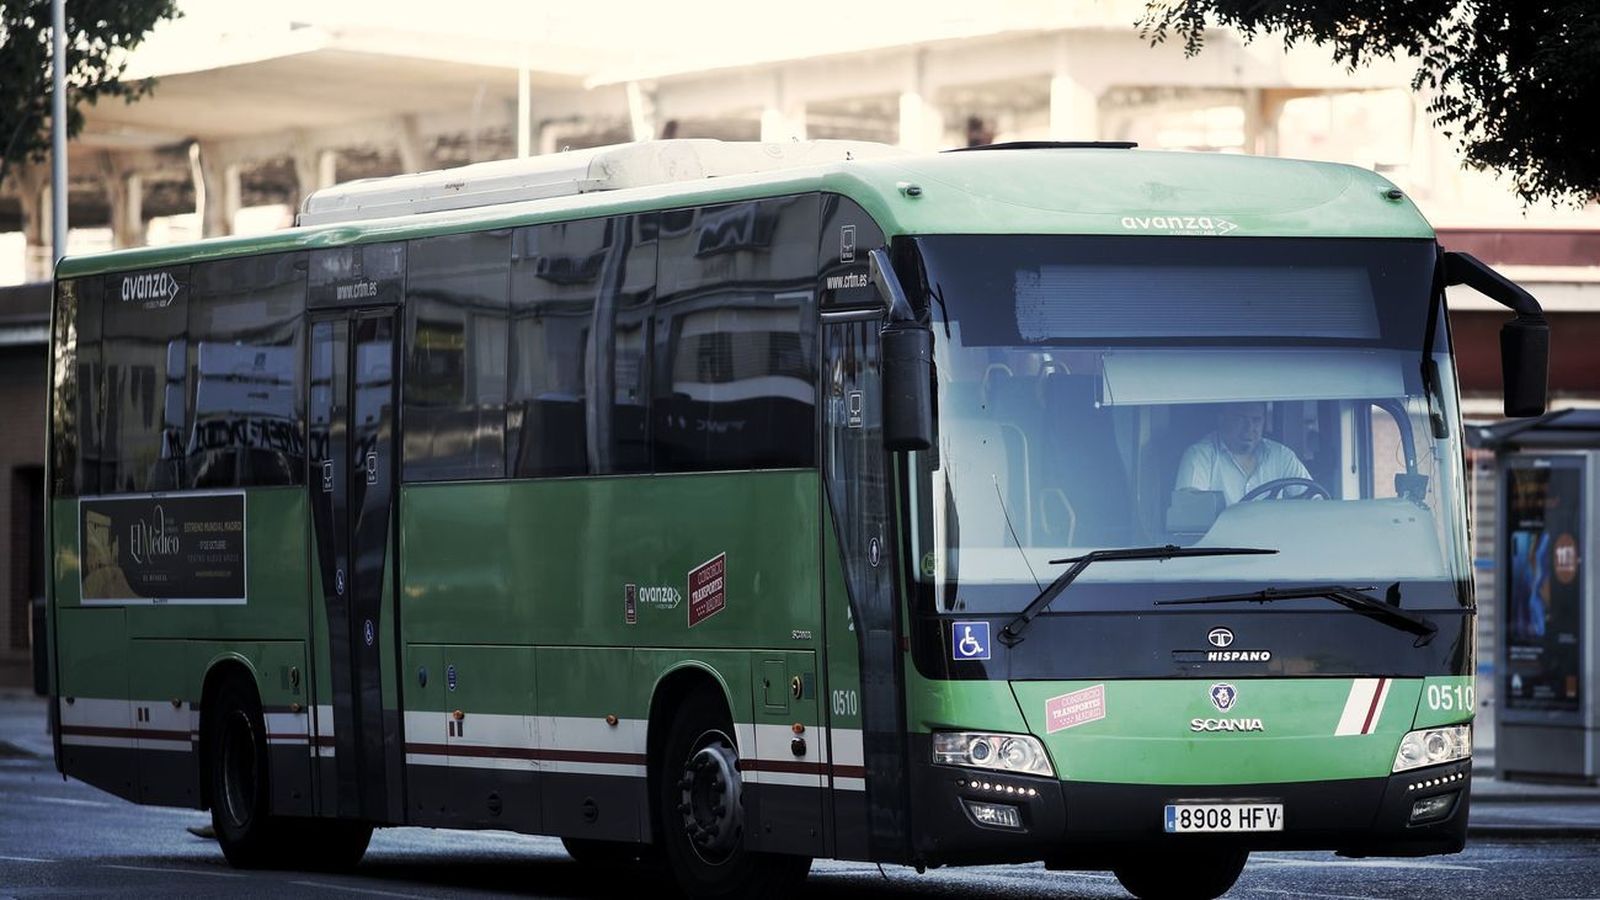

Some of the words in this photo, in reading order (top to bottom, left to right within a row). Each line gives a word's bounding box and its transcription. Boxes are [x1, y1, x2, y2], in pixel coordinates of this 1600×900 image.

[1121, 216, 1214, 230] avanza
[122, 272, 168, 301] avanza
[827, 272, 867, 289] www.crtm.es
[639, 587, 673, 602] avanza
[1208, 651, 1271, 661] HISPANO
[833, 690, 857, 715] 0510
[1427, 684, 1474, 711] 0510
[1053, 698, 1101, 719] TRANSPORTES
[1190, 718, 1264, 732] SCANIA
[1180, 808, 1232, 829] 8908
[1239, 807, 1278, 828] HFV
